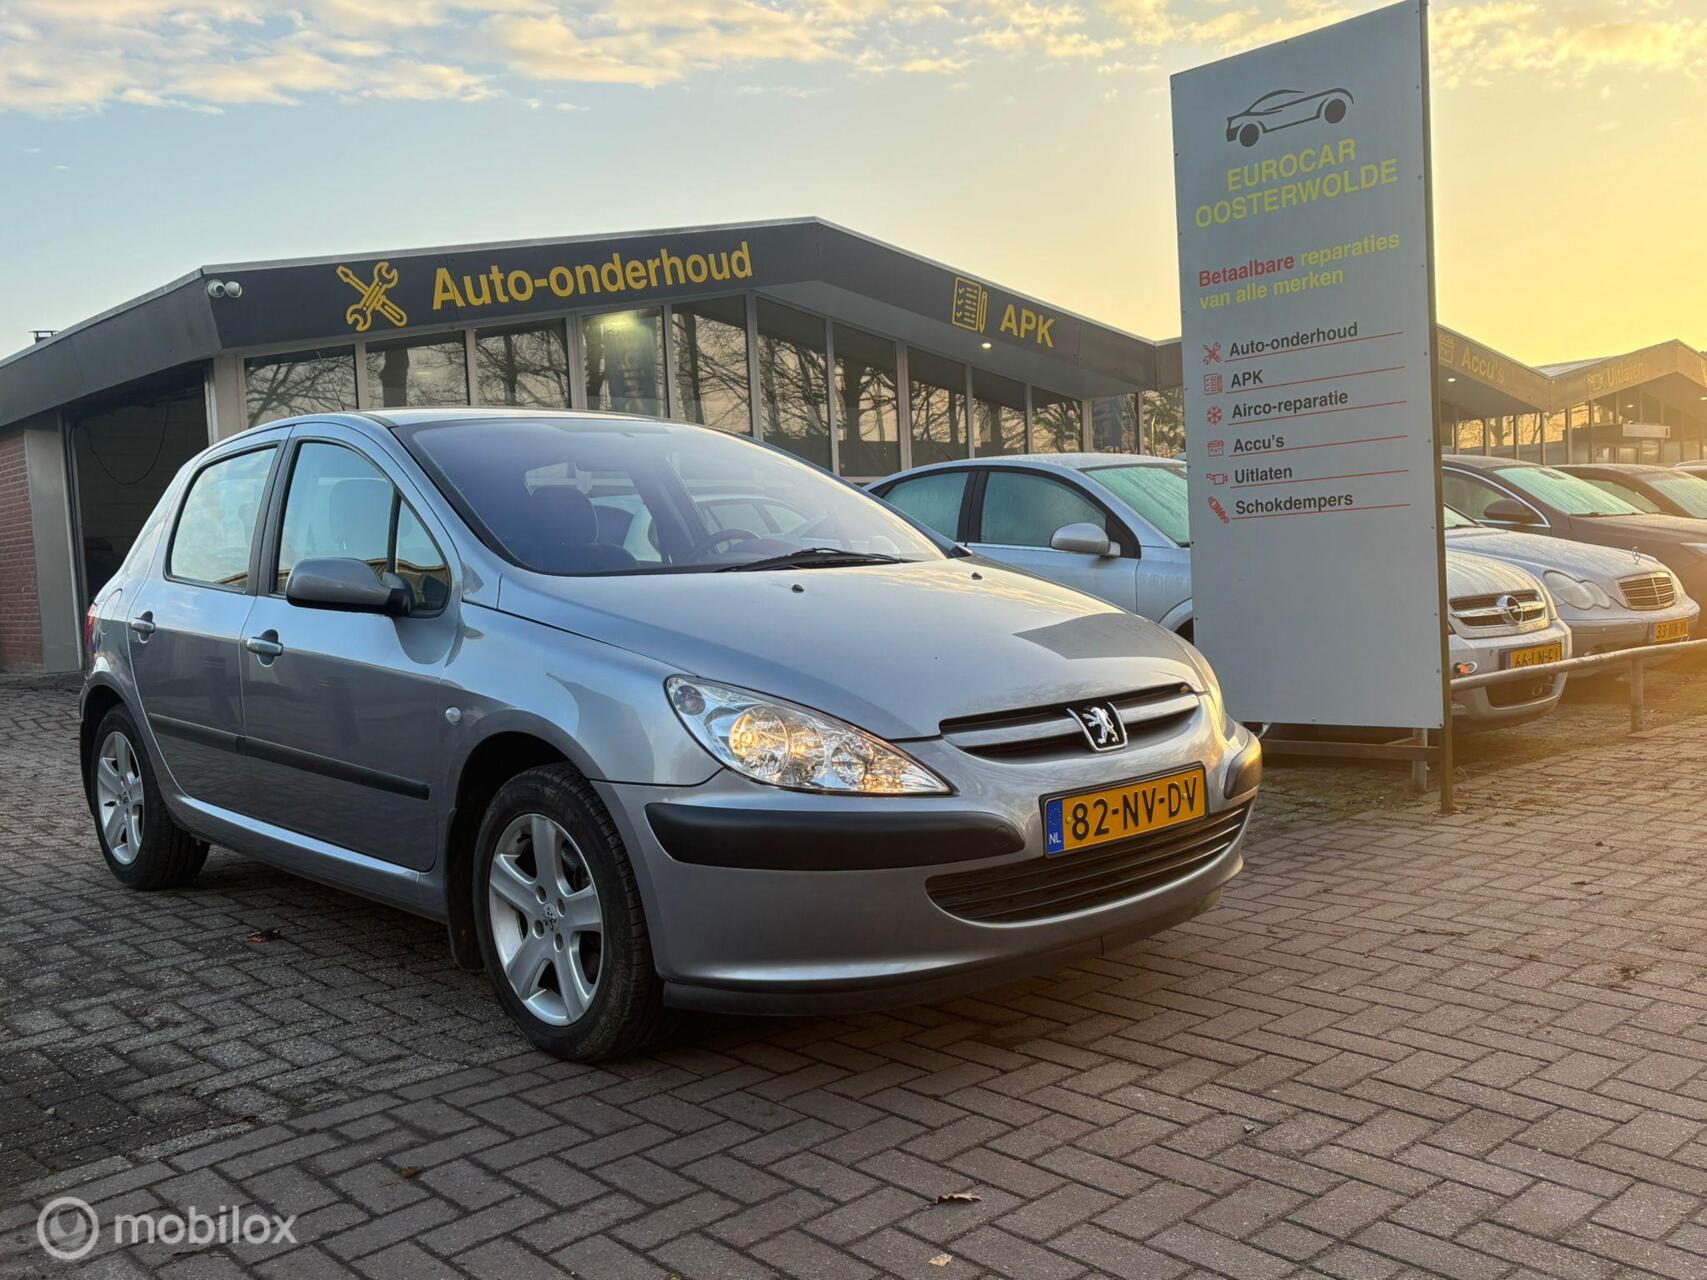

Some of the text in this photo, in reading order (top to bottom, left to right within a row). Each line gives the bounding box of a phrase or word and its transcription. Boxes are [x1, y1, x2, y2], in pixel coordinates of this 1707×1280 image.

[1226, 138, 1357, 191] EUROCAR
[1195, 158, 1398, 228] OOSTERWOLDE
[432, 240, 753, 310] Auto-onderhoud
[1199, 233, 1400, 288] Betaalbare reparaties
[1200, 268, 1344, 310] van alle merken
[1000, 303, 1056, 348] APK
[1229, 322, 1358, 357] Auto-onderhoud
[1230, 369, 1264, 388] APK
[1461, 350, 1505, 385] Accu's
[1232, 390, 1349, 419] Airco-reparatie
[1233, 434, 1285, 453] Accu's
[1234, 465, 1293, 484] Uitlaten
[1235, 493, 1354, 515] Schokdempers
[1070, 777, 1199, 841] 82-NV-DV
[1049, 829, 1062, 845] NL
